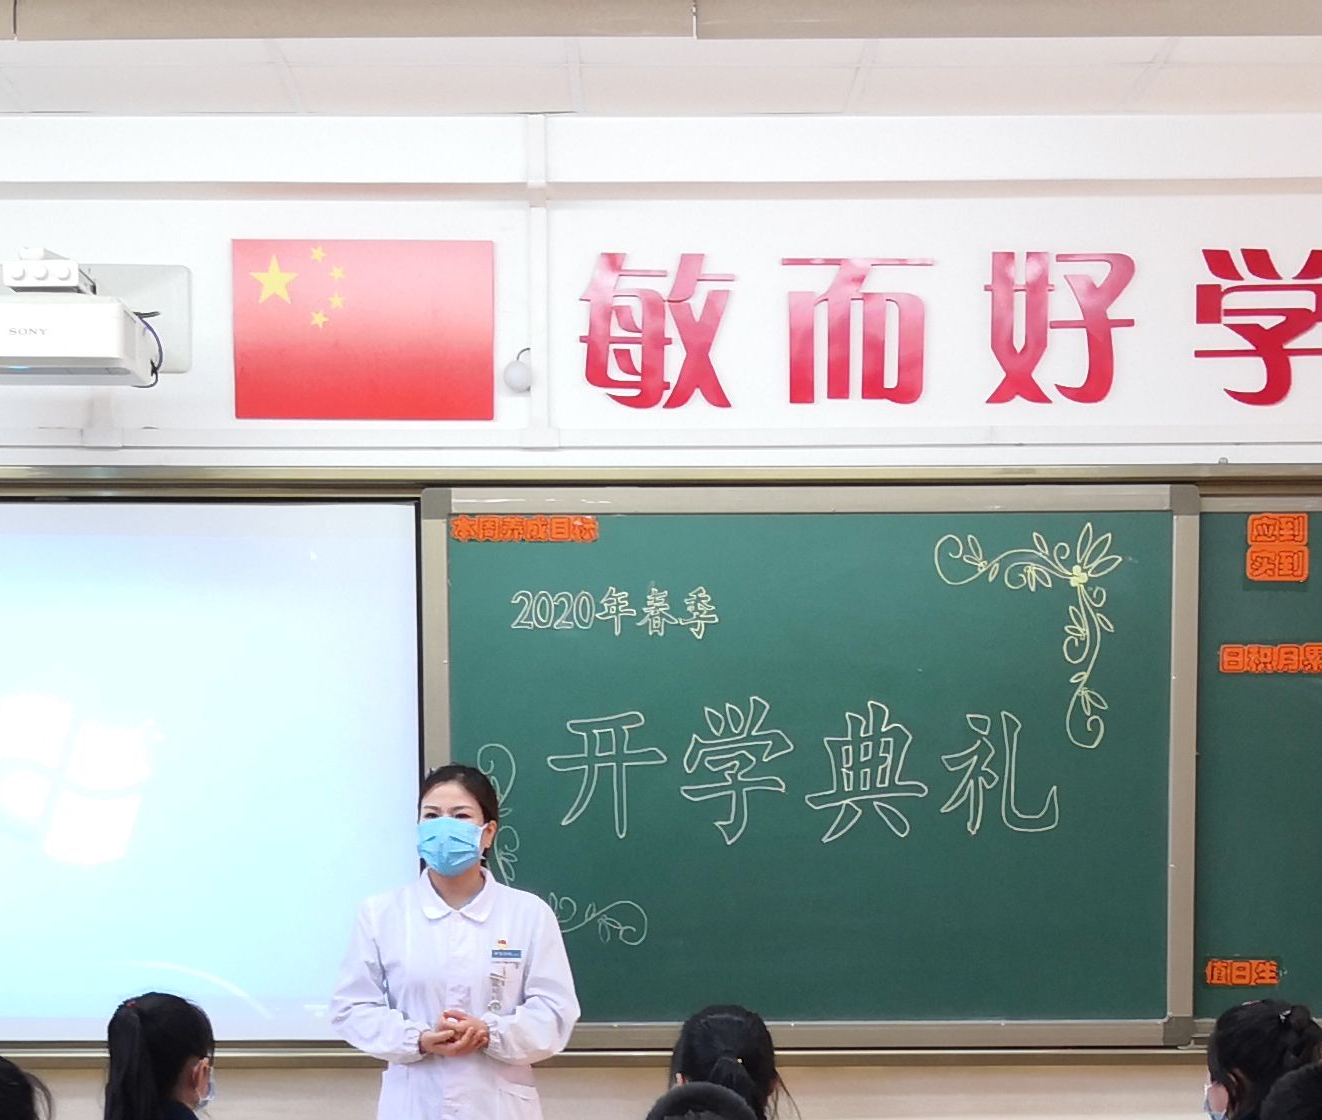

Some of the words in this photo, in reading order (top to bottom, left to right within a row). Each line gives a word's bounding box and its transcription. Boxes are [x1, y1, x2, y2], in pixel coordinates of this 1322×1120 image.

[8, 327, 48, 336] SONY
[452, 515, 598, 542] 本周养成目标
[1249, 515, 1305, 543] 应到
[1249, 549, 1305, 578] 实到
[510, 586, 719, 640] 2020年春季
[547, 696, 1059, 845] 开学典礼
[1207, 961, 1277, 985] 值日生
